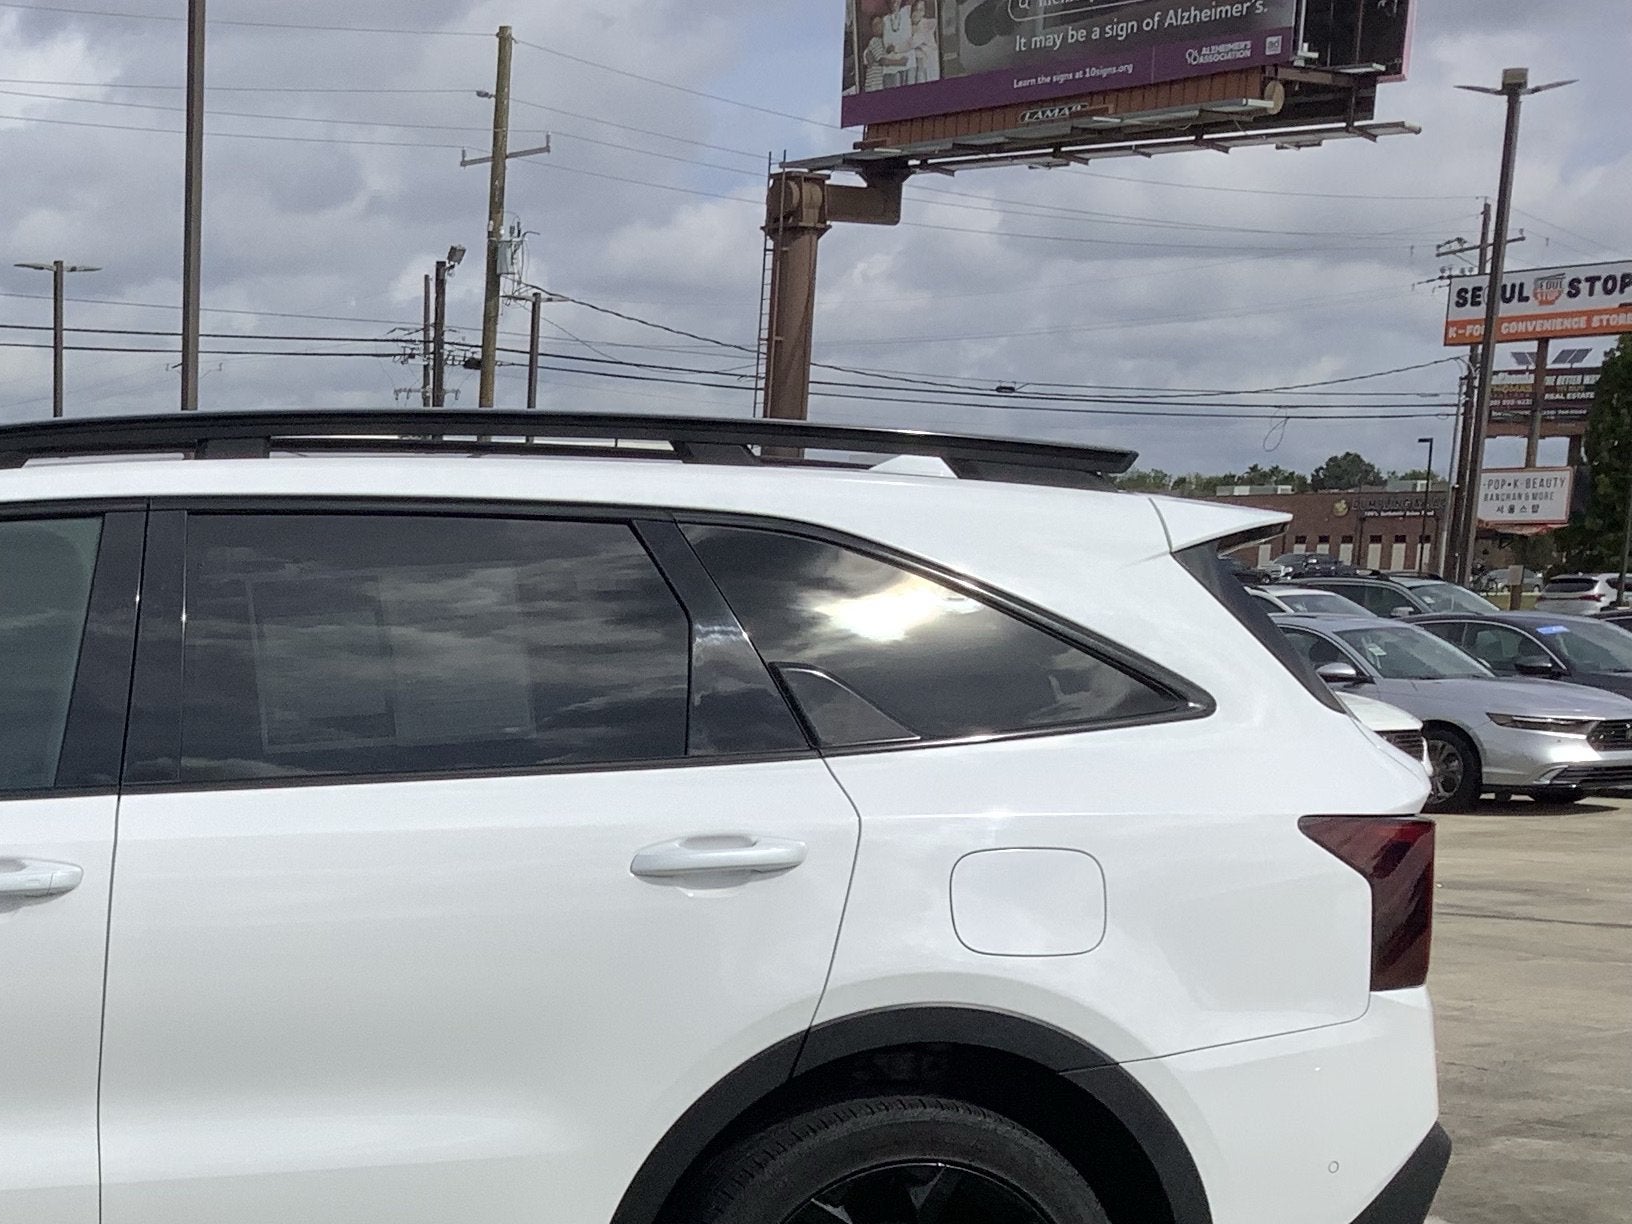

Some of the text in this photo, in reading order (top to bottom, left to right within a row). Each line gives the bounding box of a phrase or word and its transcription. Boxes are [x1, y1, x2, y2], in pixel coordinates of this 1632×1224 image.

[1016, 0, 1268, 51] It may be a sign of Alzheimer's.
[1199, 49, 1252, 63] ASSOCIATION
[1013, 64, 1134, 88] Learn the signs at 10signs.org
[1455, 273, 1632, 308] SEUL STOP
[1501, 316, 1587, 335] CONVENIENCE
[1532, 491, 1555, 501] MORE
